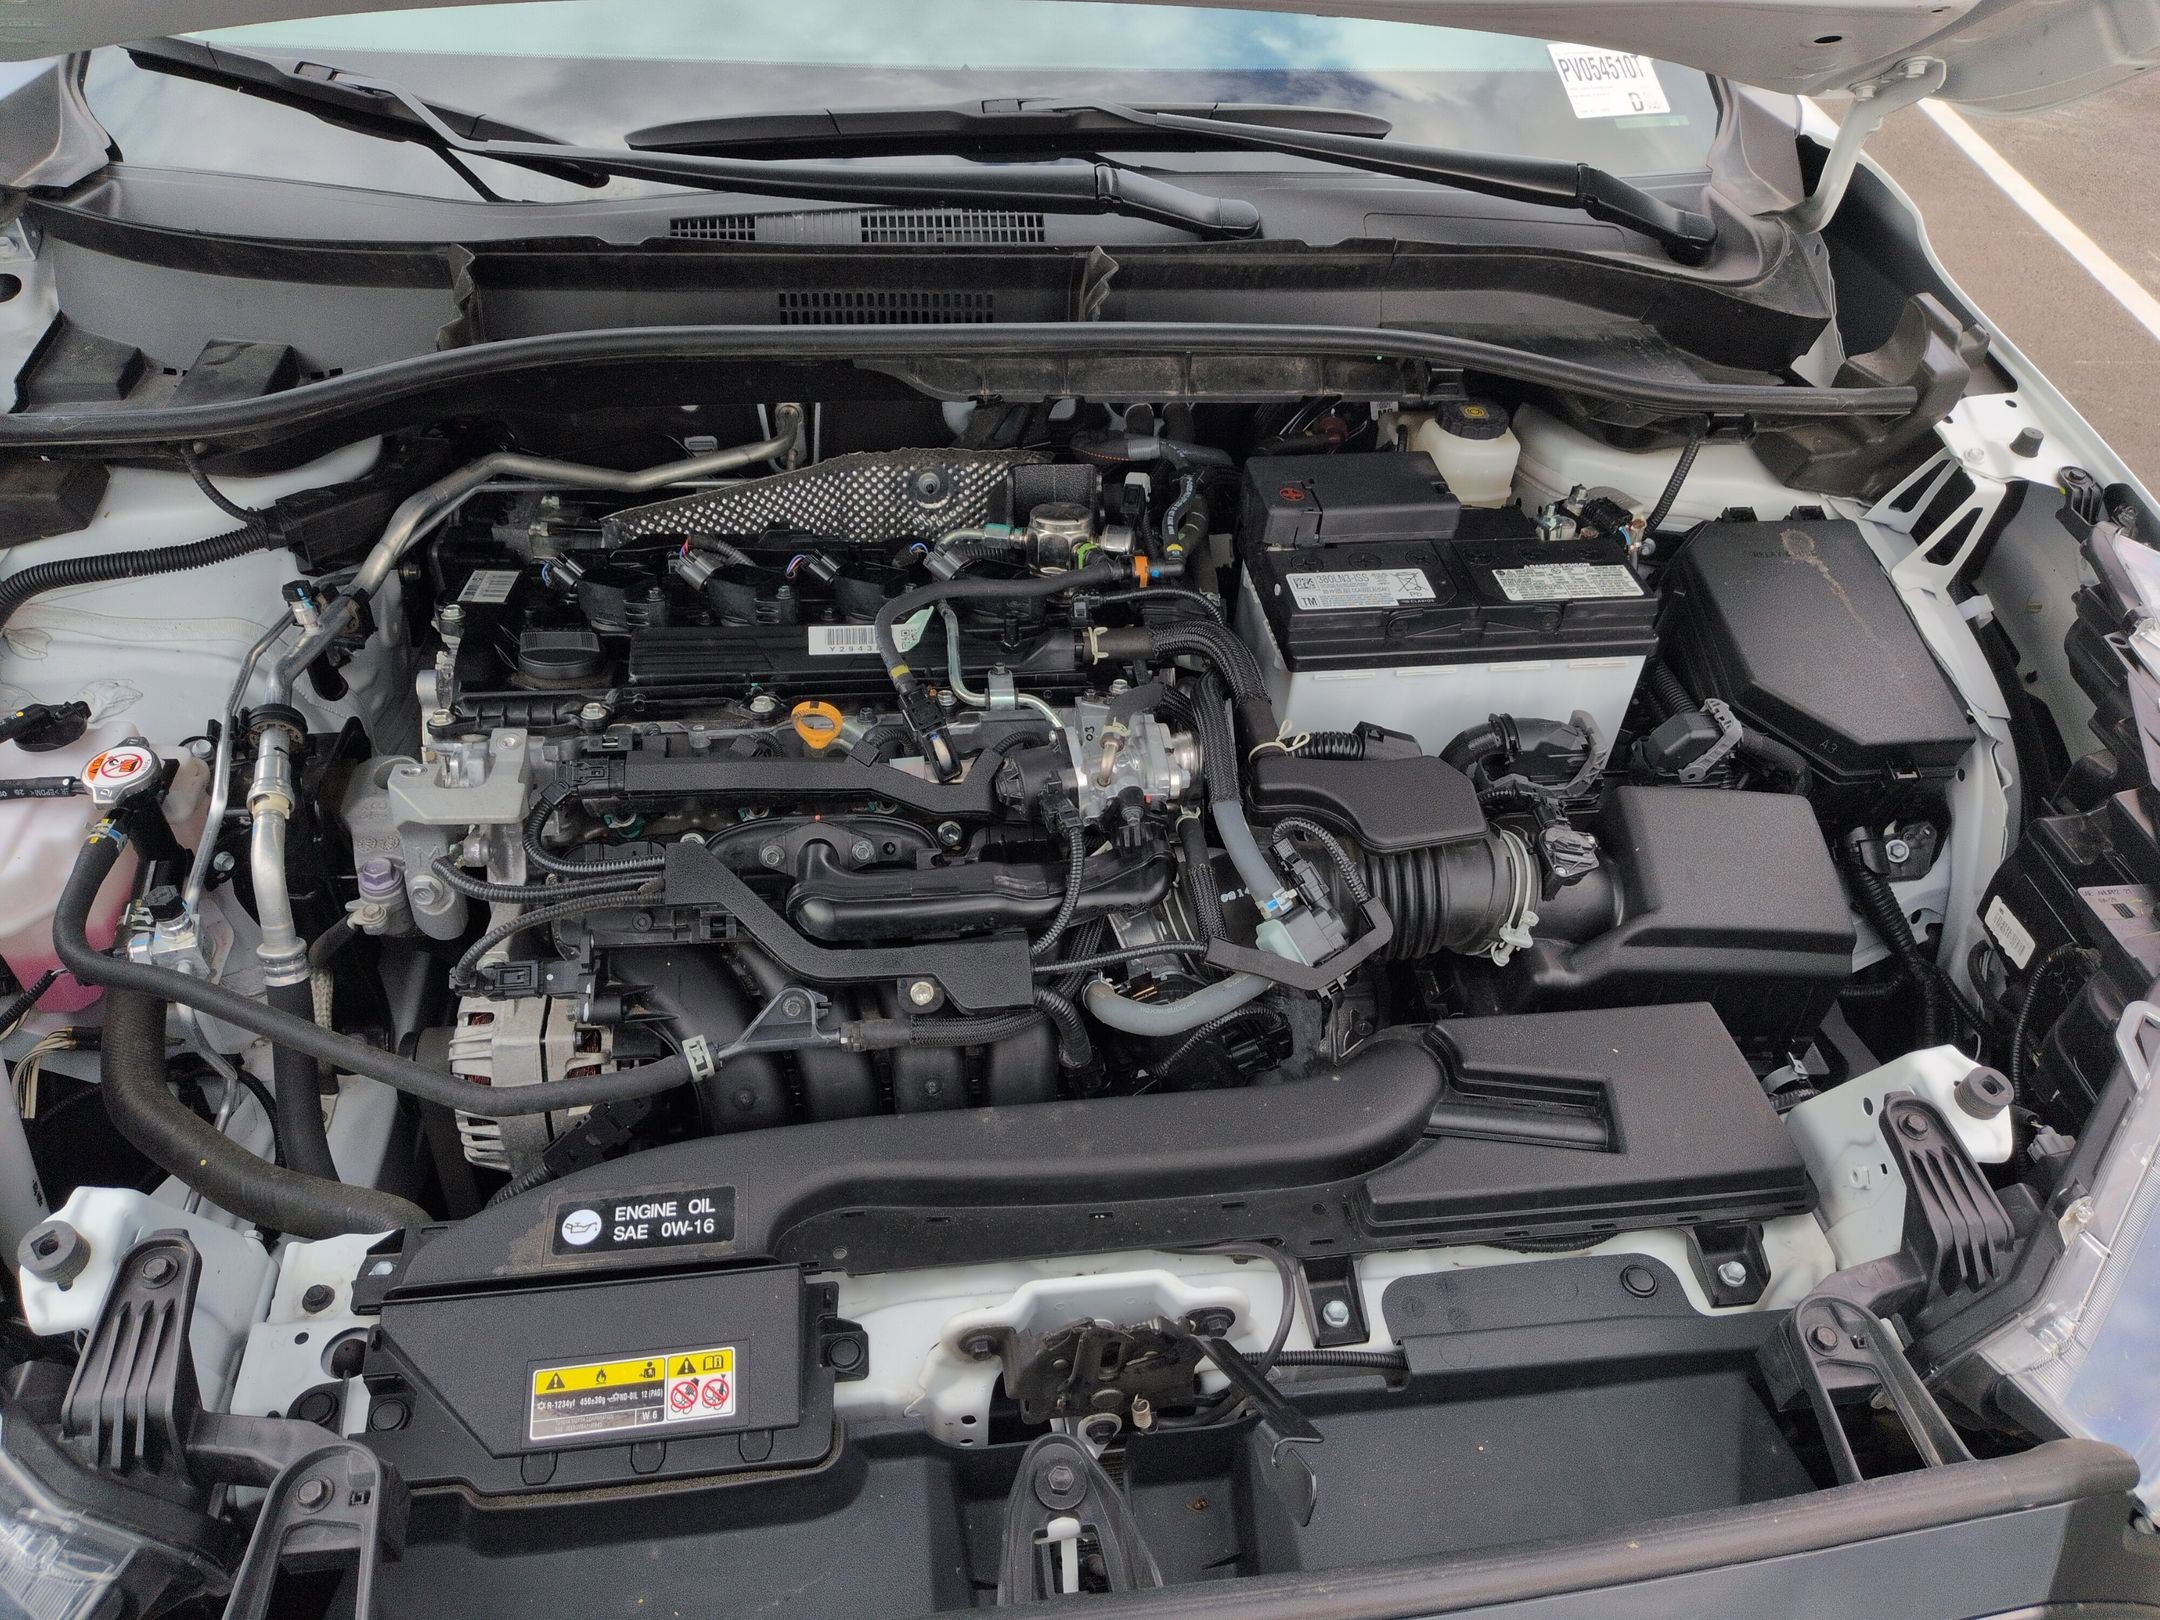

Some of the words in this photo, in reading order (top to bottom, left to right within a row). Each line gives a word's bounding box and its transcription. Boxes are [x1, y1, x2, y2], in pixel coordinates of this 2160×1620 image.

[1628, 92, 1644, 111] D
[1301, 596, 1318, 607] TM
[614, 1202, 677, 1221] ENGINE
[688, 1198, 716, 1215] OIL
[613, 1225, 649, 1242] SAE
[661, 1219, 714, 1237] 0W-16
[641, 1411, 651, 1421] W
